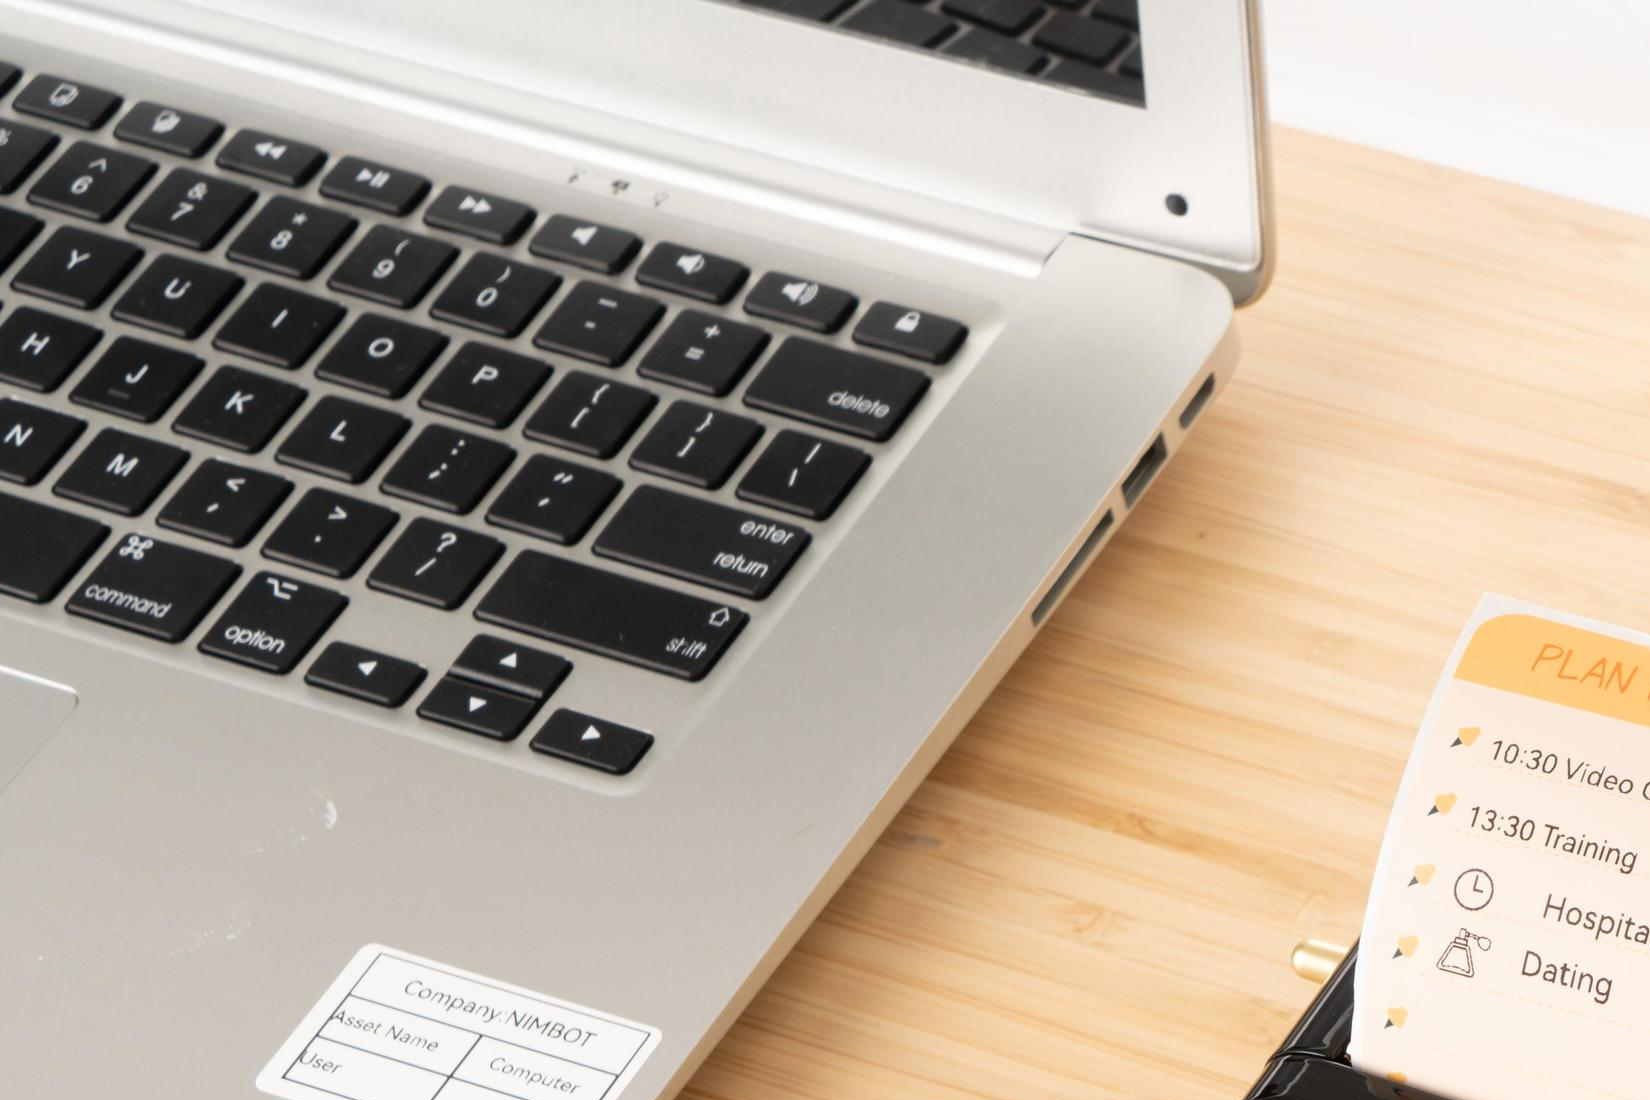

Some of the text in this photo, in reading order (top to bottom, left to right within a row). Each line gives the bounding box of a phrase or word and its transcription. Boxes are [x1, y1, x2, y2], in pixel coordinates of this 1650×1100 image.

[70, 175, 94, 195] 6
[171, 201, 195, 221] 7
[270, 230, 293, 250] 8
[67, 249, 90, 270] Y
[372, 259, 395, 279] 9
[164, 278, 191, 299] U
[476, 287, 498, 307] 0
[21, 332, 50, 355] H
[368, 337, 395, 358] O
[125, 364, 149, 384] J
[471, 365, 499, 384] P
[224, 391, 254, 414] K
[827, 391, 890, 418] delete
[4, 423, 33, 447] N
[329, 420, 347, 442] L
[106, 453, 139, 477] M
[739, 520, 795, 546] enter
[713, 551, 769, 578] return
[84, 582, 172, 620] command
[224, 625, 286, 654] option
[1530, 643, 1639, 694] PLAN
[1493, 740, 1558, 775] 10:30
[1567, 757, 1634, 795] Video
[1471, 806, 1638, 875] 13:30 Training
[1521, 950, 1613, 1005] Dating
[404, 979, 599, 1049] Company:NIMBOT
[330, 1008, 441, 1053] Asset Name
[298, 1049, 344, 1075] User
[488, 1055, 583, 1097] Computer
